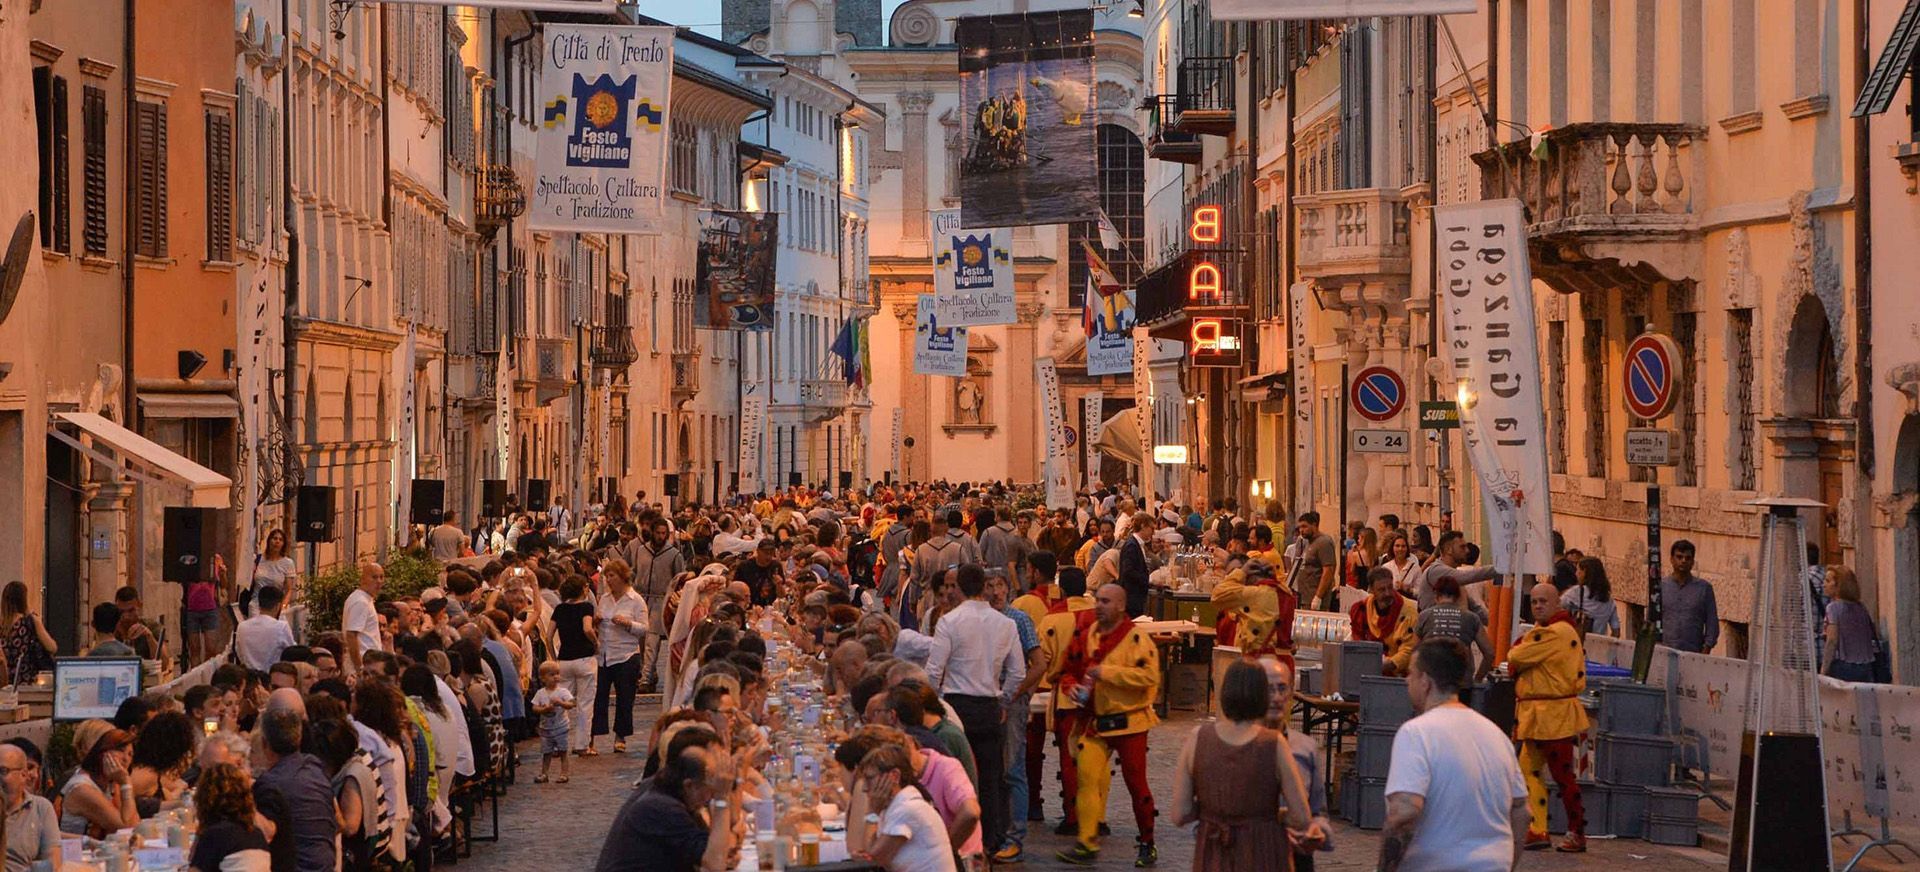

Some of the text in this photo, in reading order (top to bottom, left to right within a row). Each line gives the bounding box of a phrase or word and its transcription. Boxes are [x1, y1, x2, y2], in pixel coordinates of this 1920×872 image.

[597, 34, 610, 61] di
[620, 34, 664, 65] Trento
[581, 126, 618, 145] Feste
[569, 143, 630, 163] Vigiliane
[605, 177, 658, 204] Cultura
[555, 198, 635, 220] e Tradizione
[955, 273, 993, 287] Vigiliane
[962, 265, 985, 276] Feste
[1358, 435, 1368, 446] 0
[1385, 435, 1403, 447] 24
